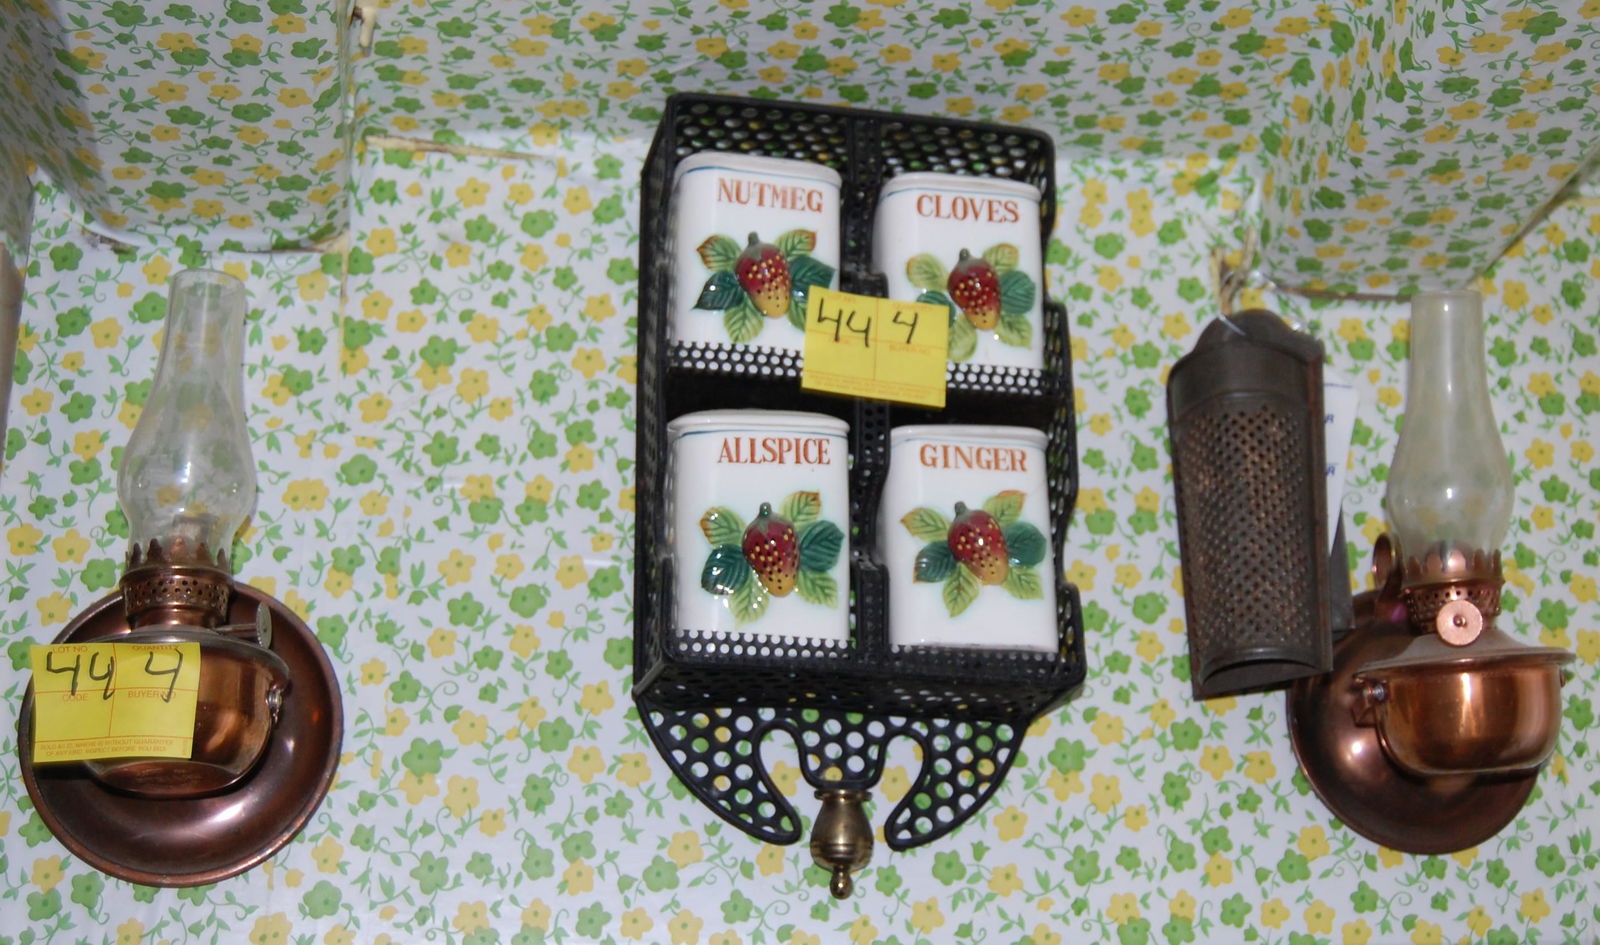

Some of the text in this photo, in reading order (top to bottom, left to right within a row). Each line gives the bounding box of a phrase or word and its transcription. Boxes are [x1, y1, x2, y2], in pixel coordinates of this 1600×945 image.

[717, 177, 824, 213] NUTMEG
[916, 193, 1020, 223] CLOVES
[817, 297, 919, 348] 44 4
[717, 436, 831, 465] ALLSPICE
[919, 443, 1028, 472] GINGER
[52, 646, 70, 654] LOT
[46, 648, 184, 703] 44 4
[127, 689, 160, 699] BUYER
